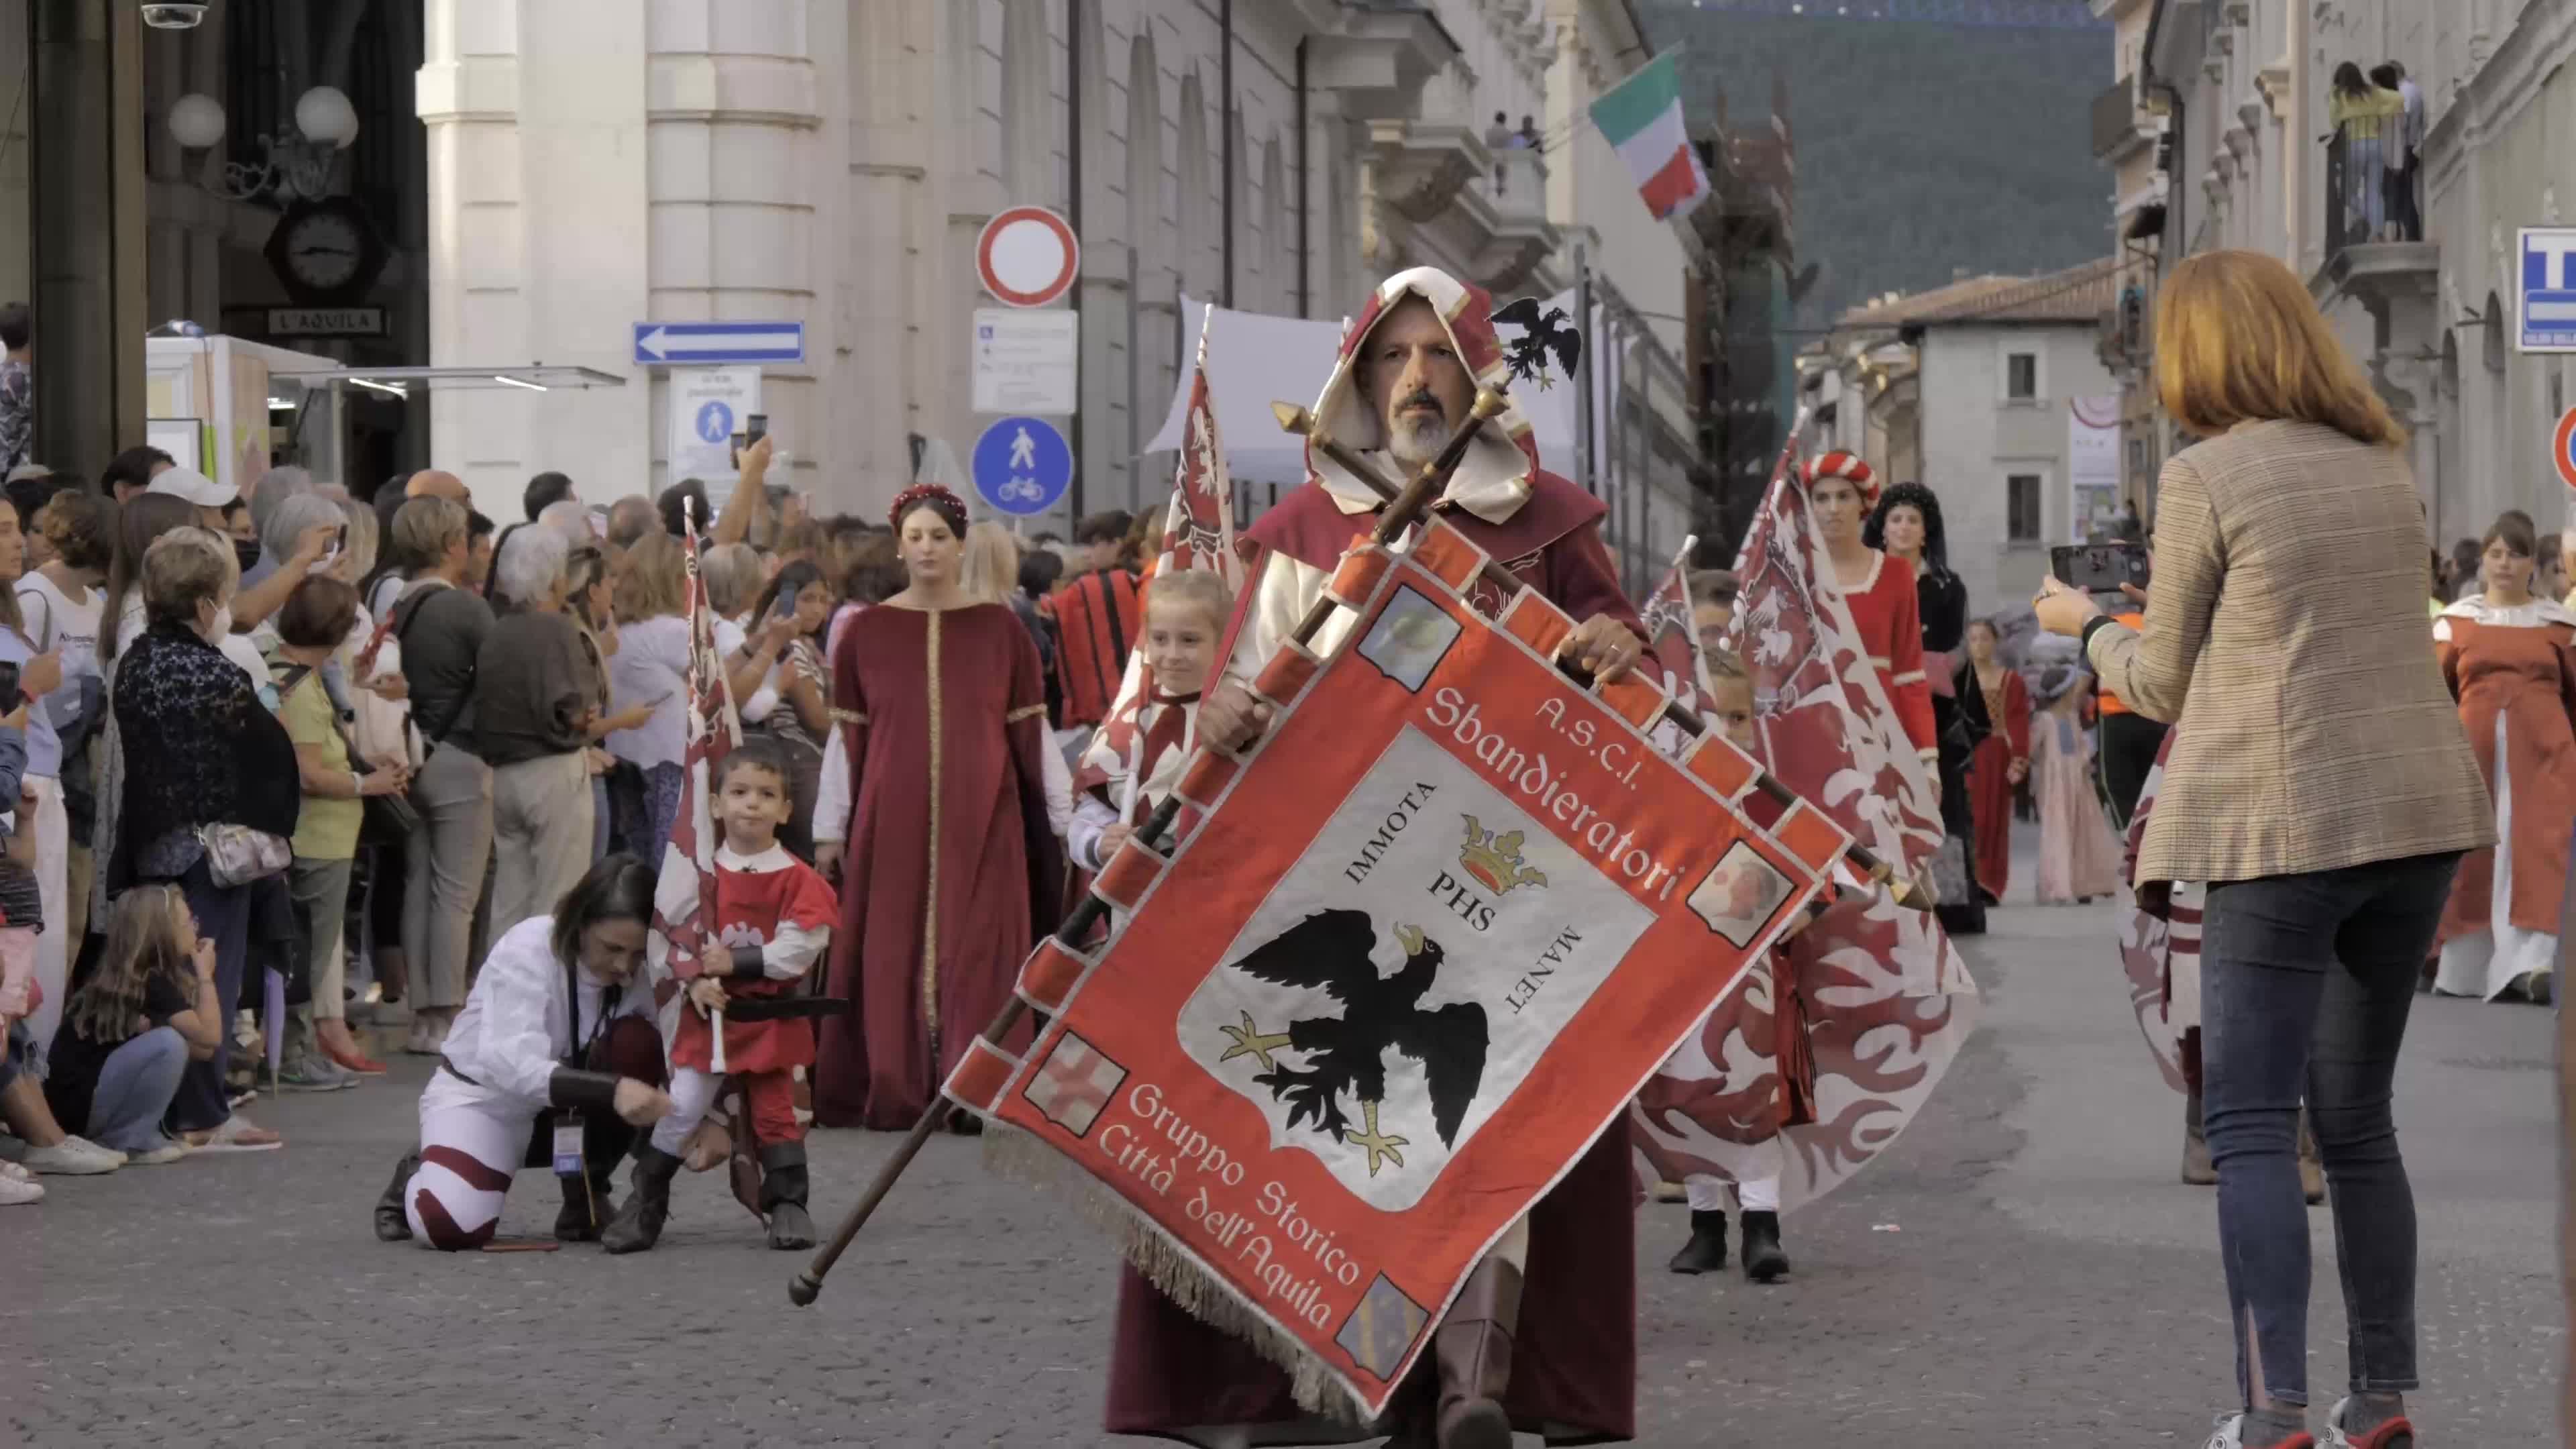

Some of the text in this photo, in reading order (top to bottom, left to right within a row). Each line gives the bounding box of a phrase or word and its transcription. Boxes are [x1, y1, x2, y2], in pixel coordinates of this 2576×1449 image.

[280, 311, 370, 329] L'AQUILA
[1534, 697, 1641, 790] A.S.C.I.
[1344, 781, 1437, 885] IMMOTA
[1425, 686, 1686, 902] Sbandieratori
[1426, 869, 1496, 932] PHS
[1503, 924, 1583, 1015] MANET
[1099, 1124, 1332, 1330] Città dell'Aquila
[1129, 1083, 1359, 1286] Gruppo Storico
